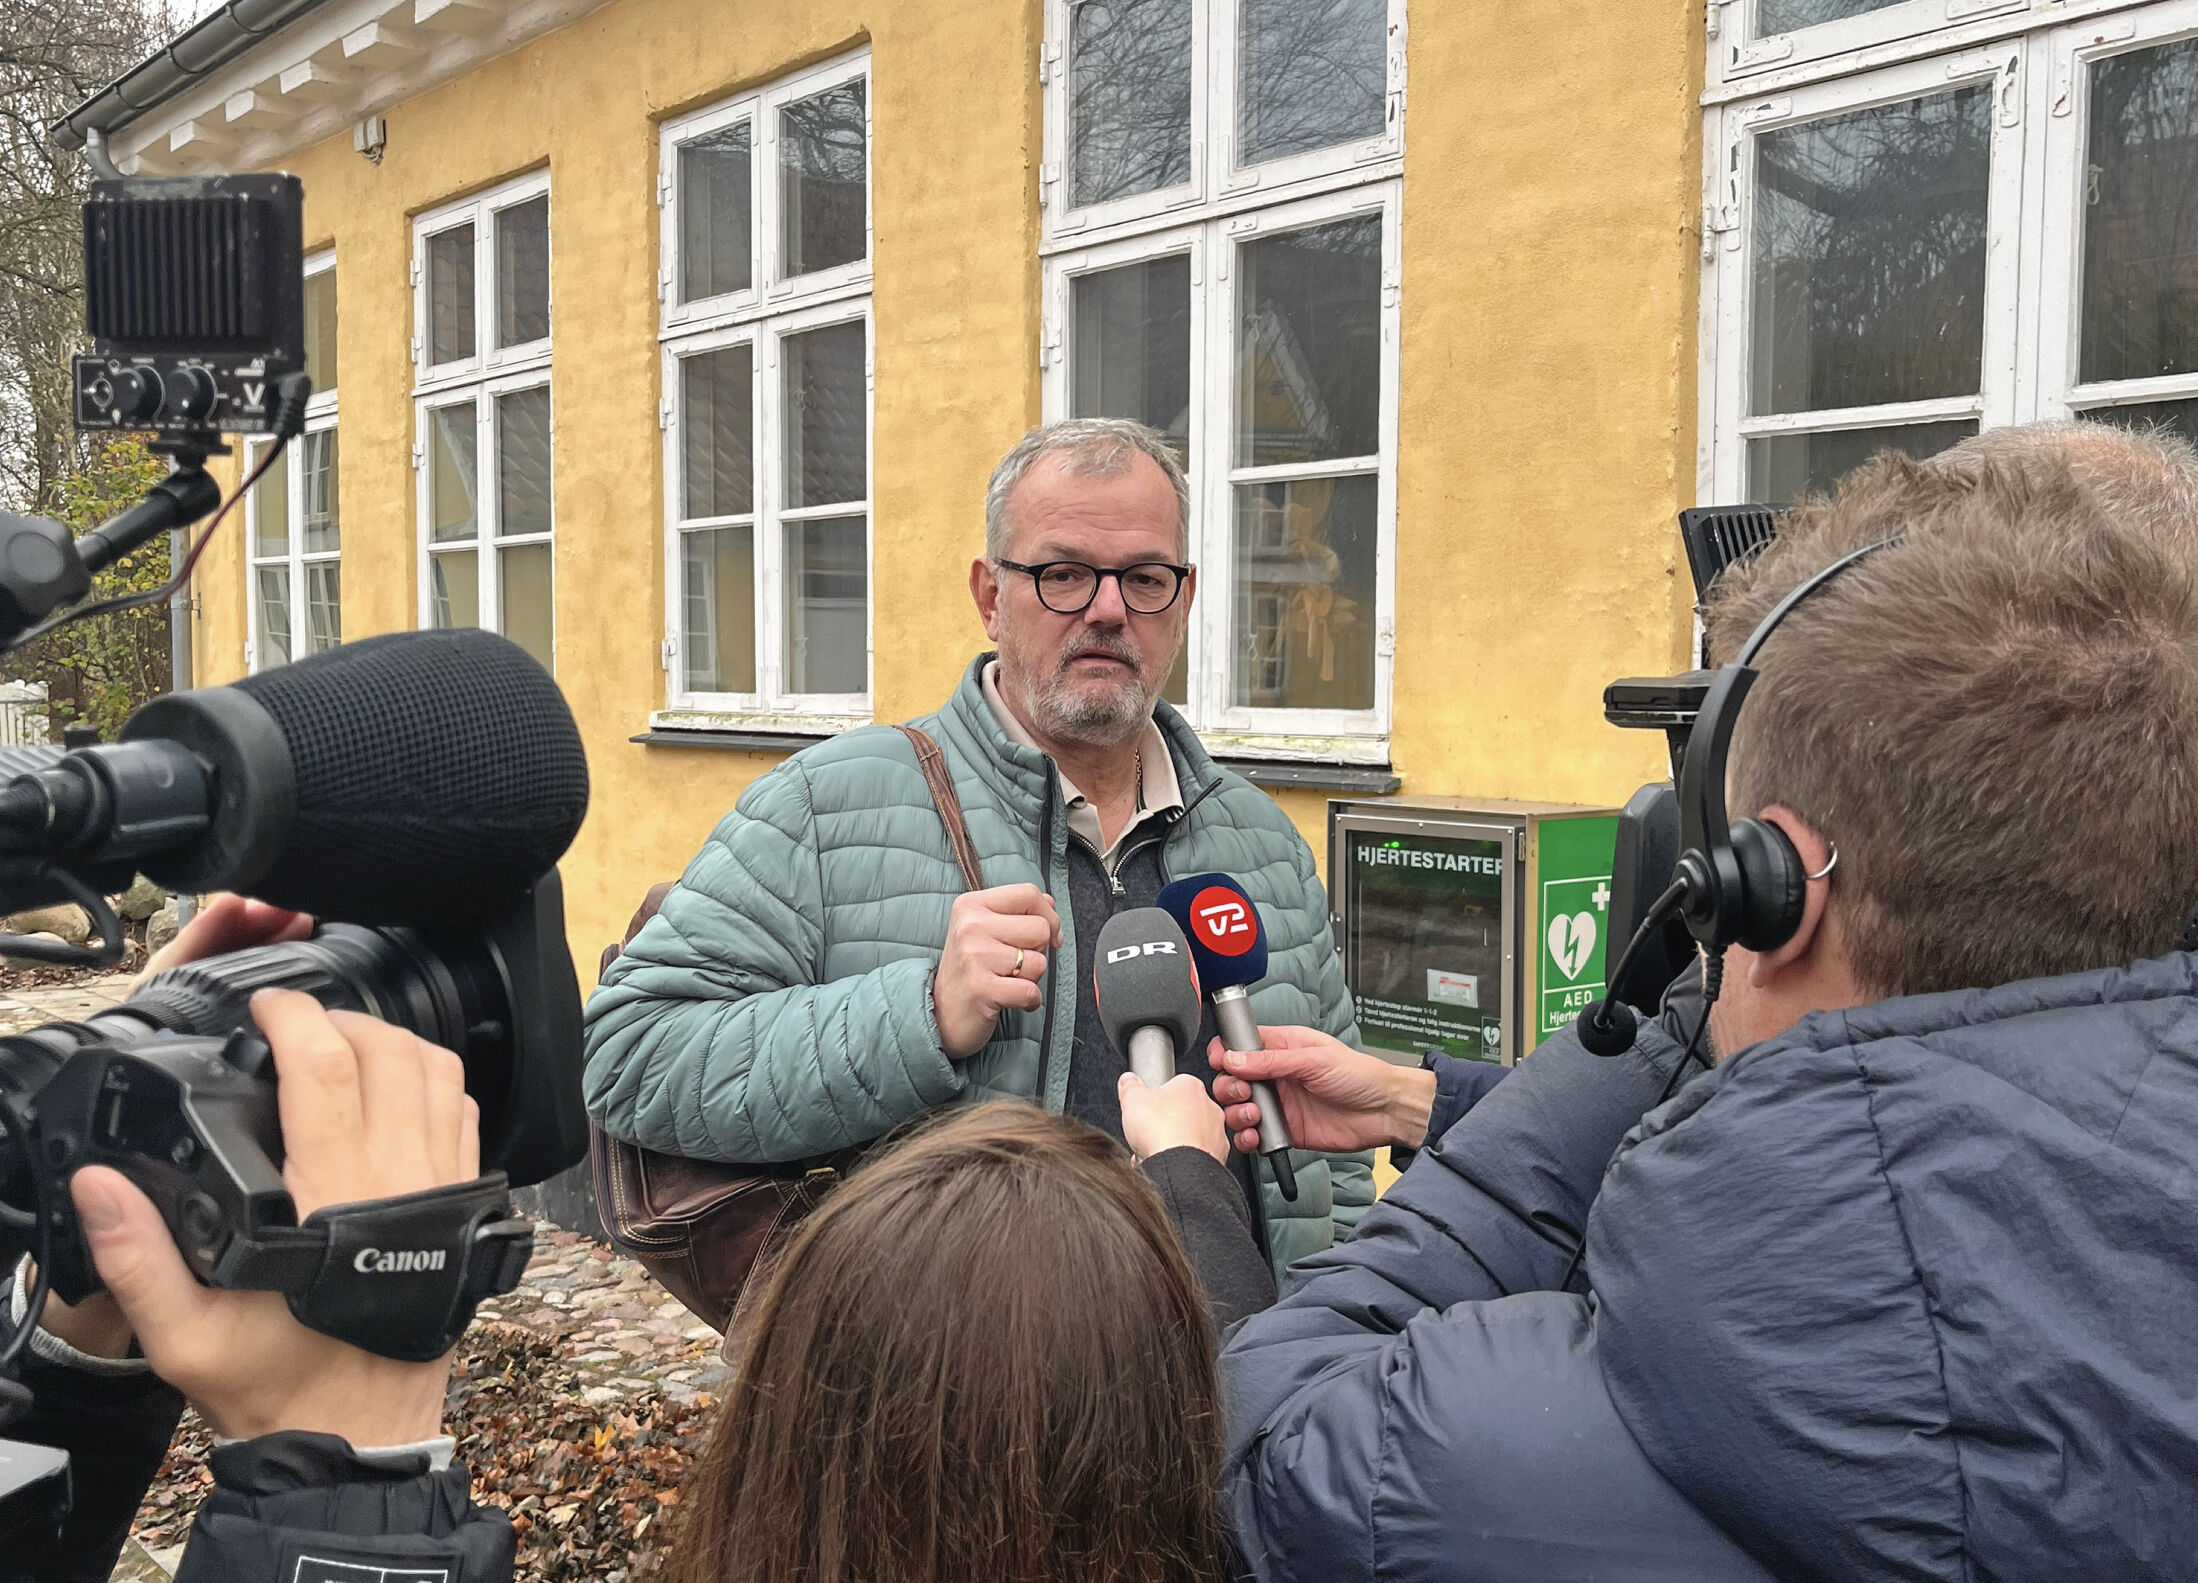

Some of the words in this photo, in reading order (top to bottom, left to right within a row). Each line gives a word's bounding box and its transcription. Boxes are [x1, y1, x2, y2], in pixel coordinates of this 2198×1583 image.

[1107, 941, 1178, 964] DR
[1563, 990, 1593, 1008] AED
[353, 1247, 447, 1273] Canon
